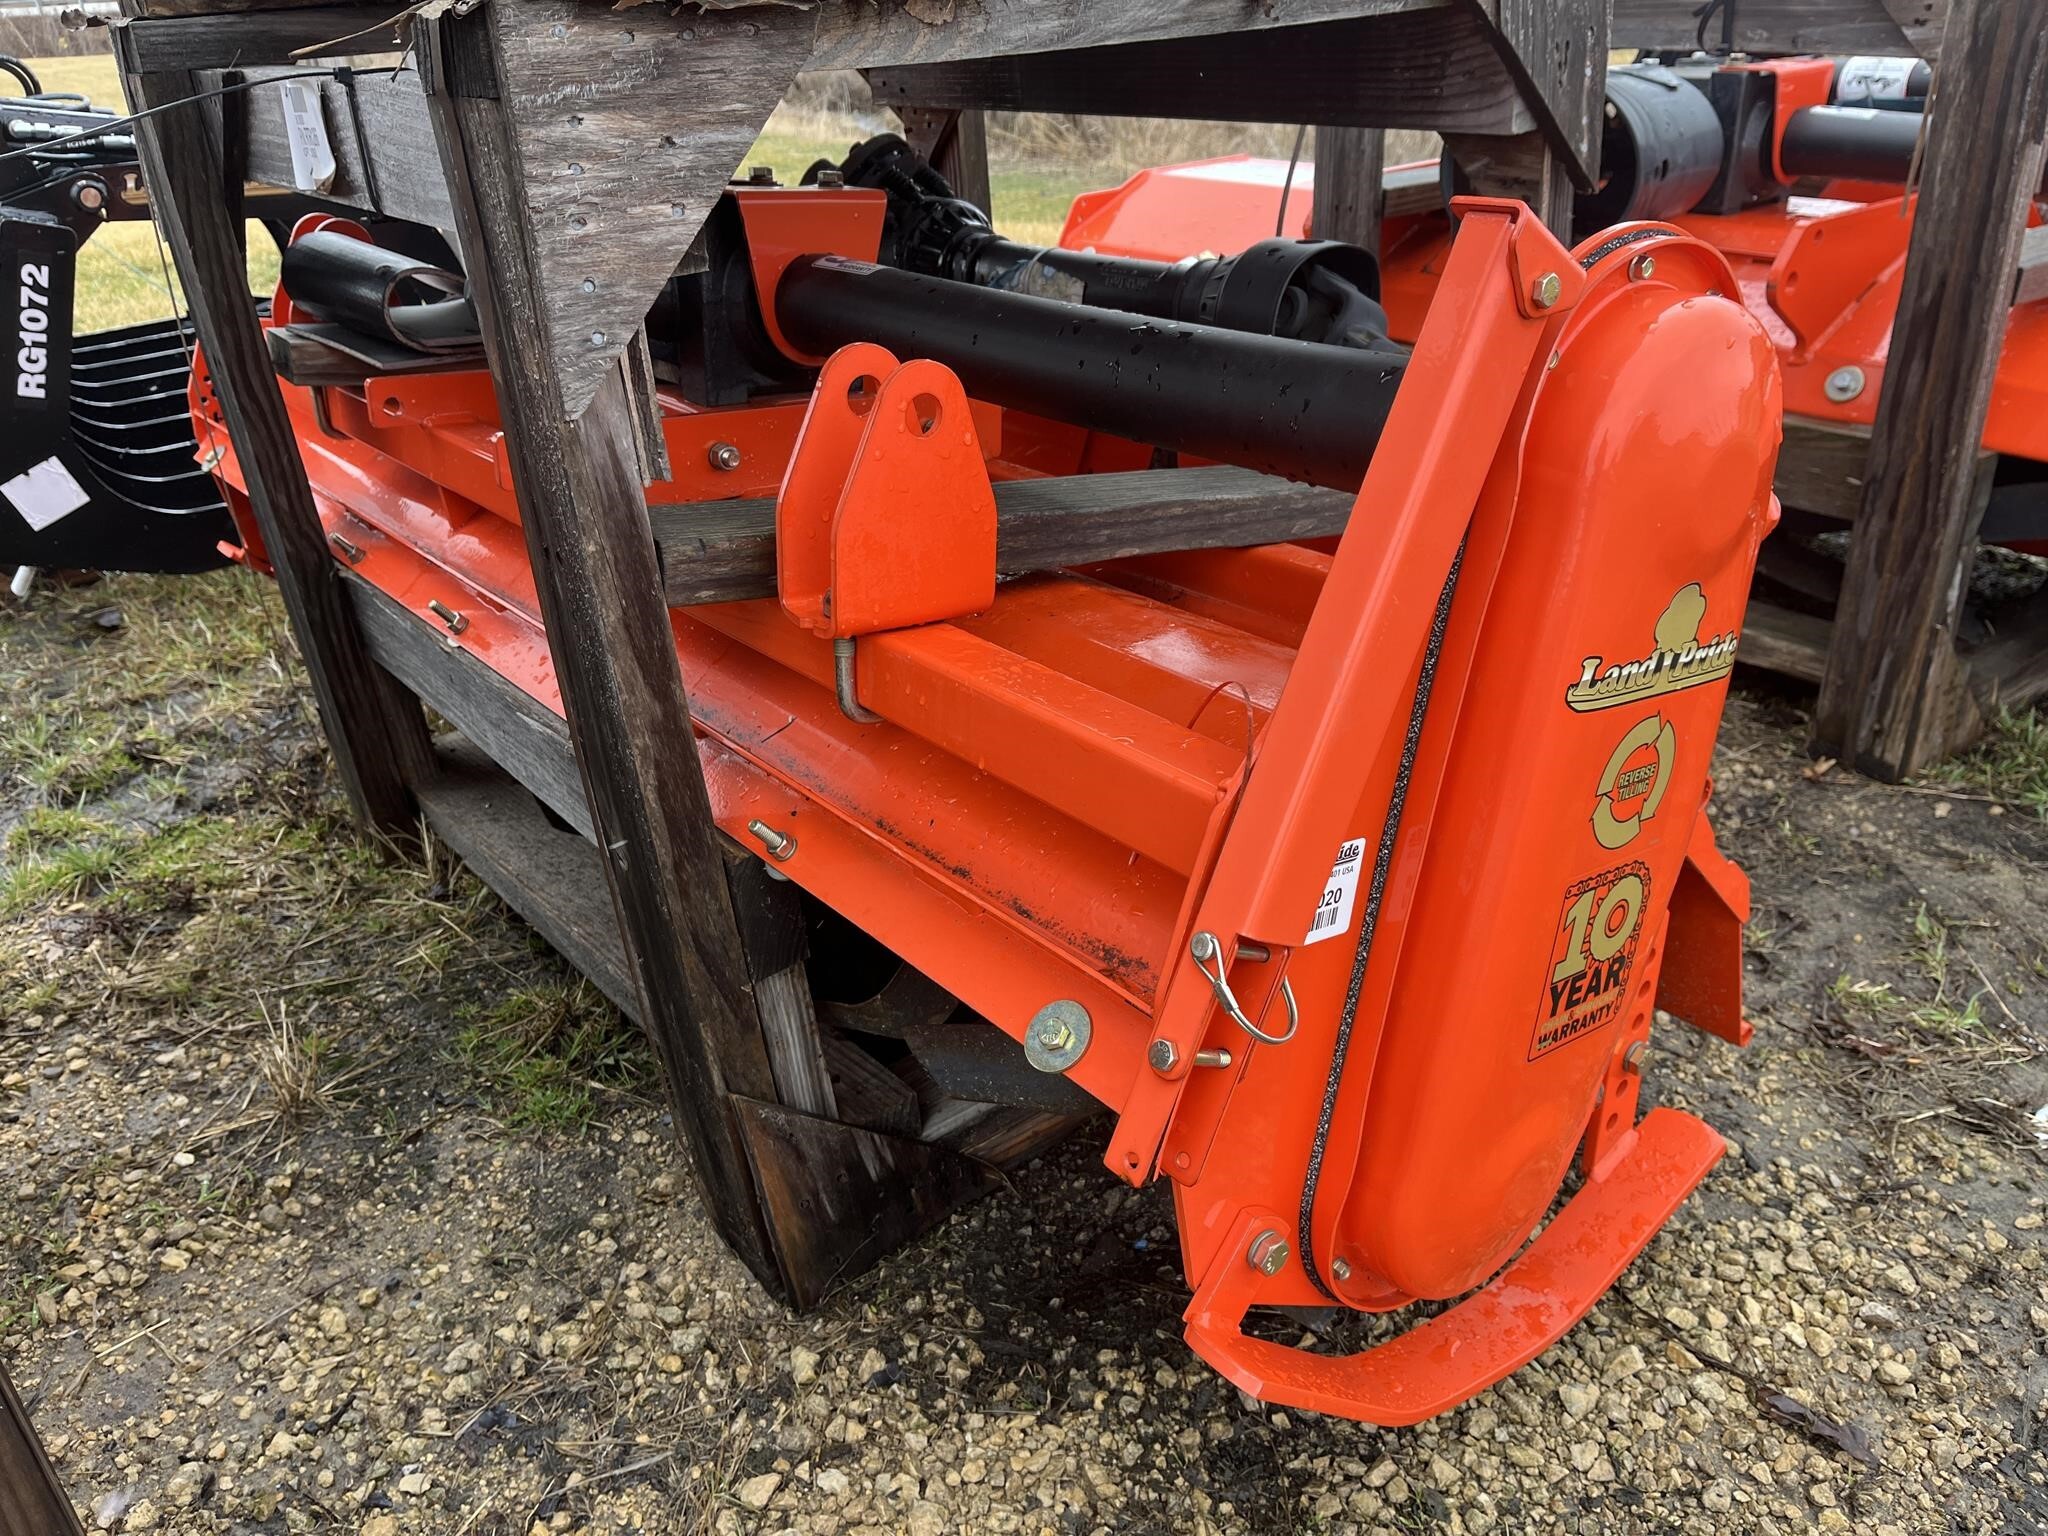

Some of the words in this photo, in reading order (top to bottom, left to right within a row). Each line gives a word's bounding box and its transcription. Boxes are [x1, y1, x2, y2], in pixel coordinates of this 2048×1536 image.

[17, 262, 50, 399] RG1072
[1571, 648, 1657, 697] Land
[1671, 630, 1738, 679] Pride
[1617, 779, 1650, 802] TILLING
[1618, 762, 1657, 788] REVERSE
[1337, 842, 1360, 860] ide
[1551, 874, 1645, 985] 10
[1550, 956, 1626, 1018] YEAR
[1537, 1000, 1615, 1051] WARRANTY
